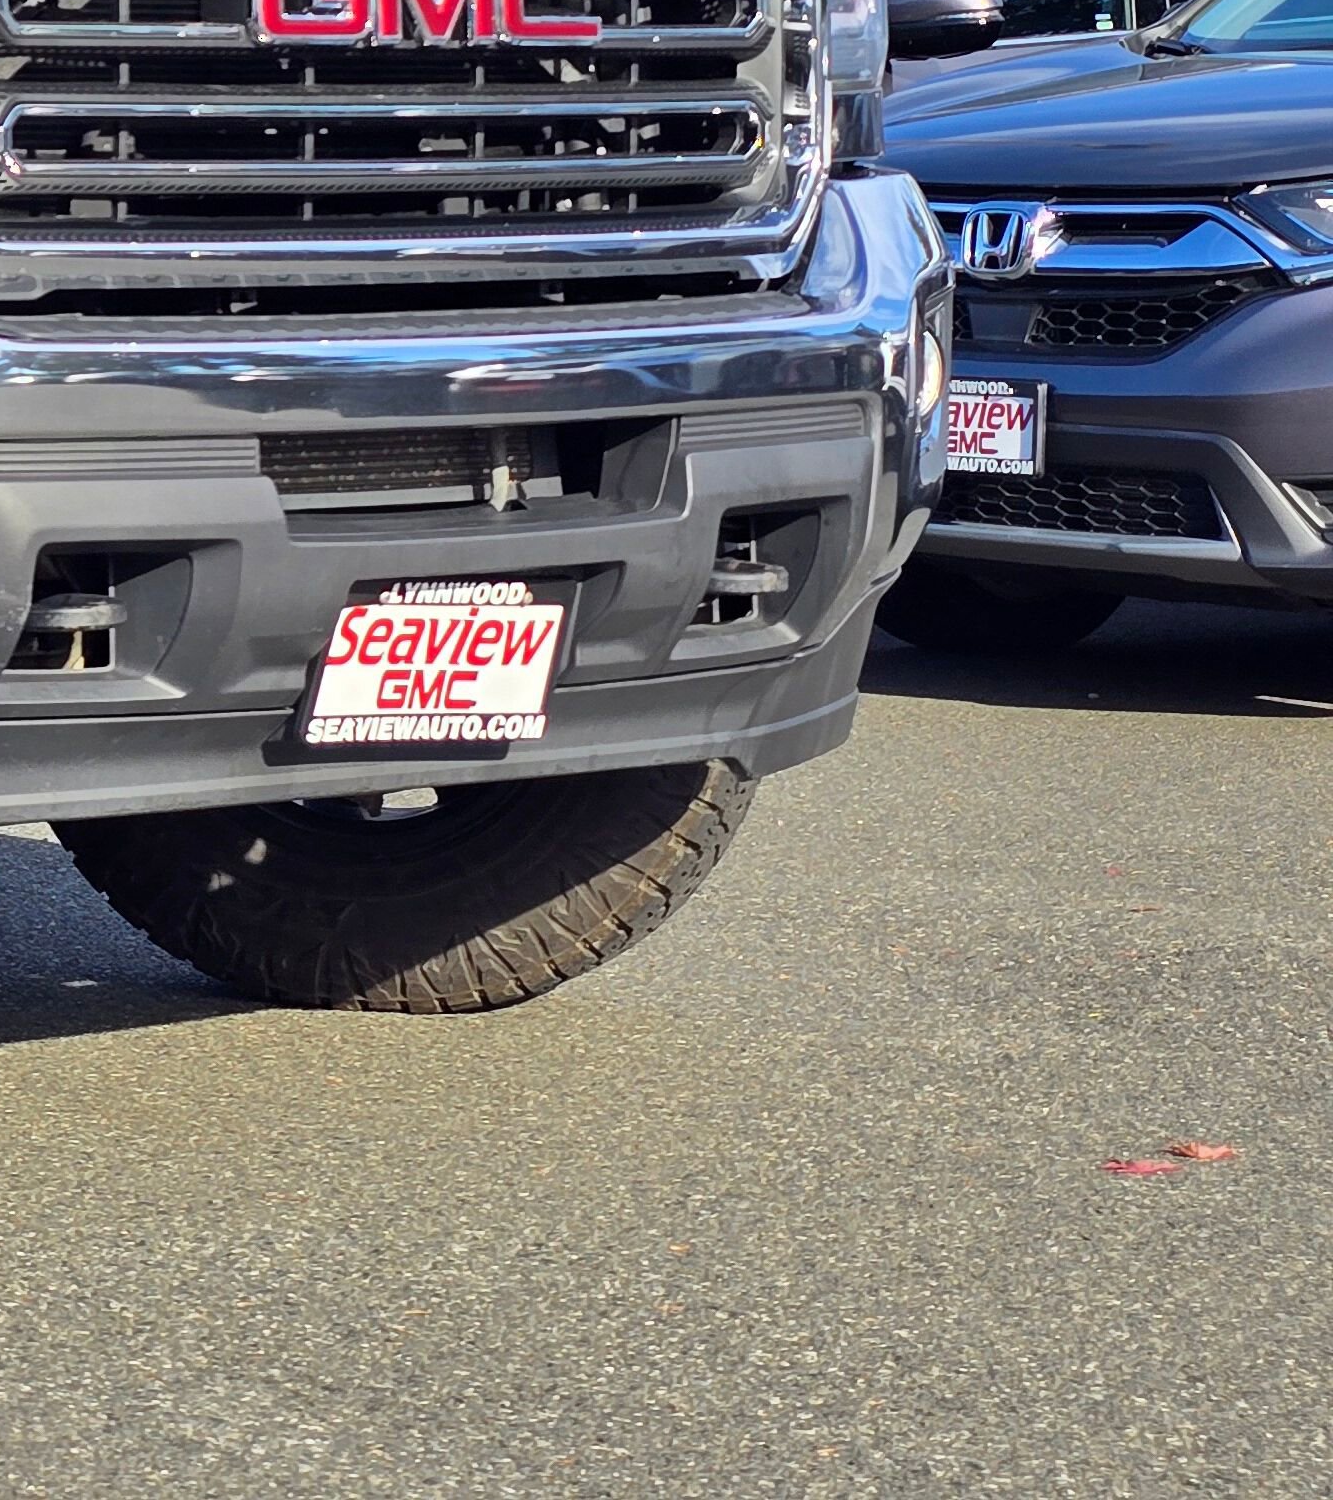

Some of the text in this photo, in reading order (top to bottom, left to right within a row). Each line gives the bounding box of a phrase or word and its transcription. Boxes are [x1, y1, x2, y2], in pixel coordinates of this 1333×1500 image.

[948, 379, 1009, 394] NNWOOD
[947, 394, 1034, 432] aview
[947, 457, 1034, 475] WAUTO.COM
[387, 581, 527, 605] LYNNWOOD
[324, 605, 556, 666] Seaview
[376, 669, 479, 709] GMC
[305, 714, 547, 744] SEAVIEWAUTO.COM
